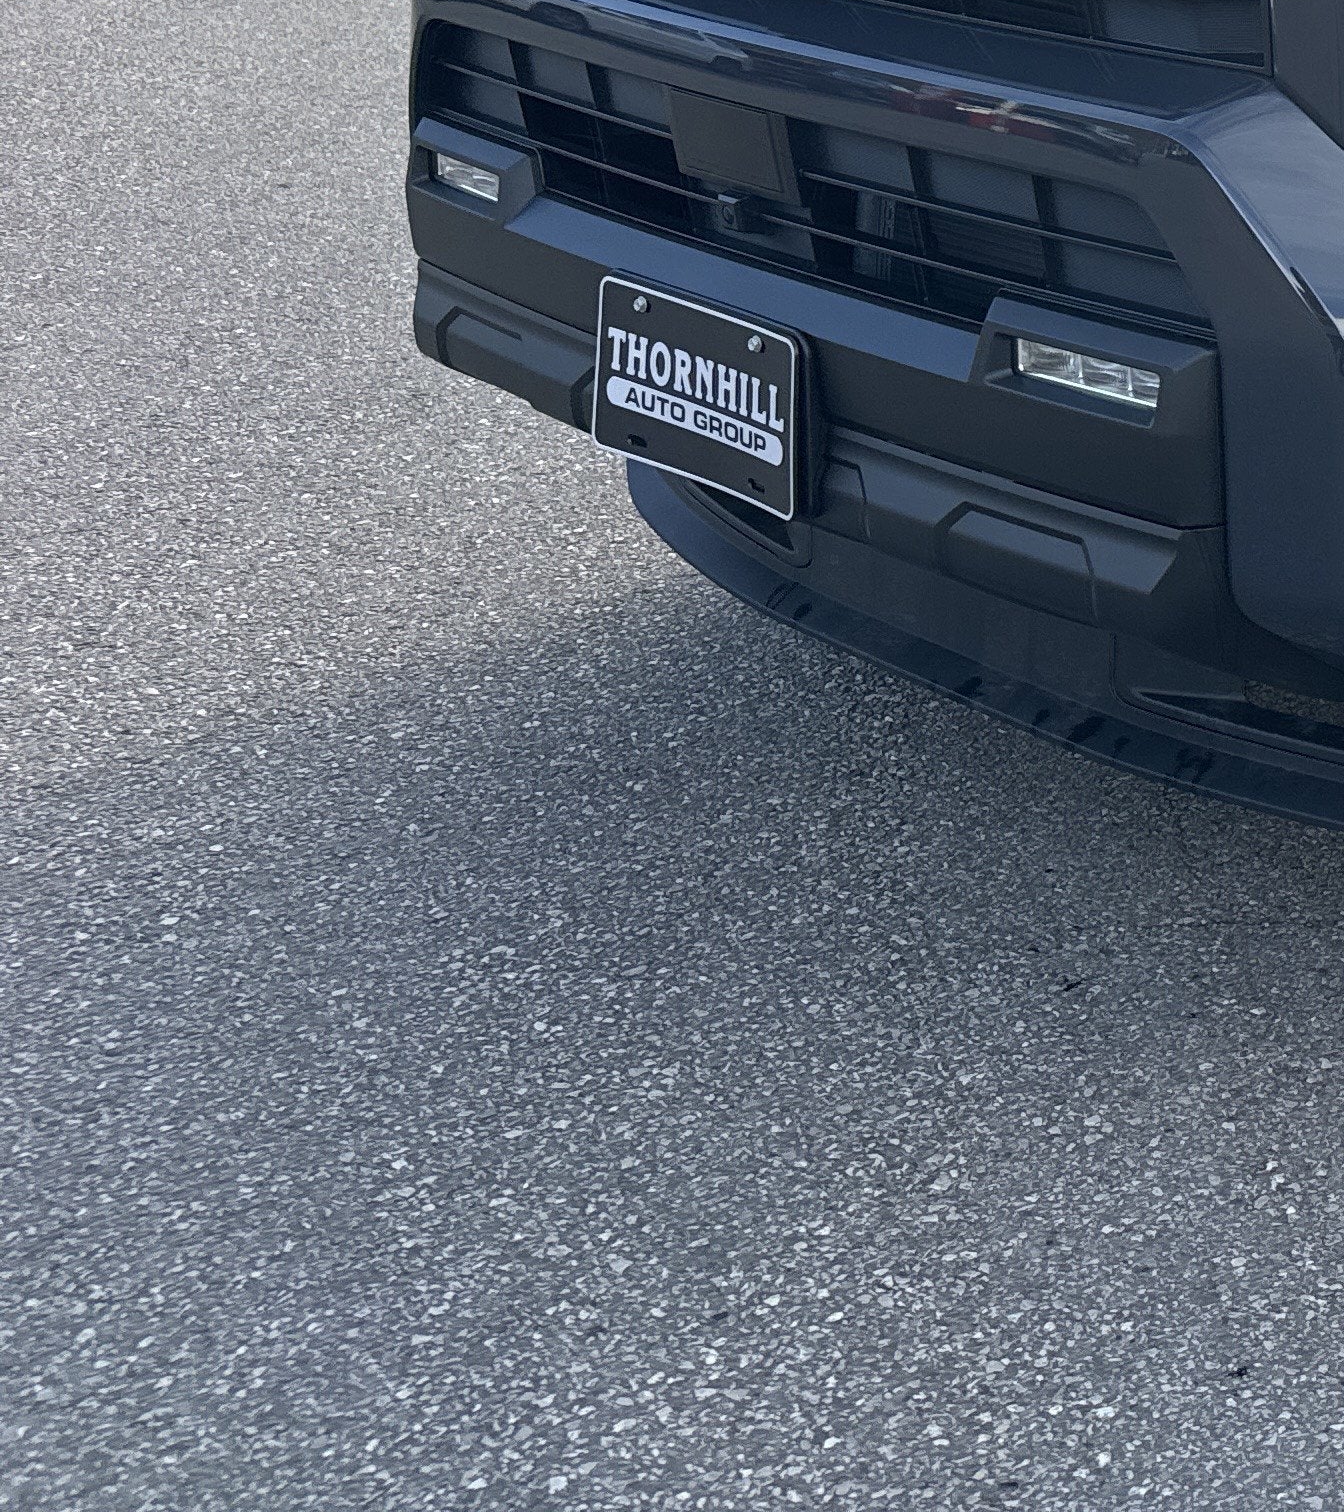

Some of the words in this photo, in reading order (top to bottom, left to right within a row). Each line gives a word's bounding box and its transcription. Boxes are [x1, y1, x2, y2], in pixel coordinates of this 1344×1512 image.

[608, 326, 784, 433] THORNHILL
[625, 388, 685, 423] AUTO
[693, 410, 767, 452] GROUP
